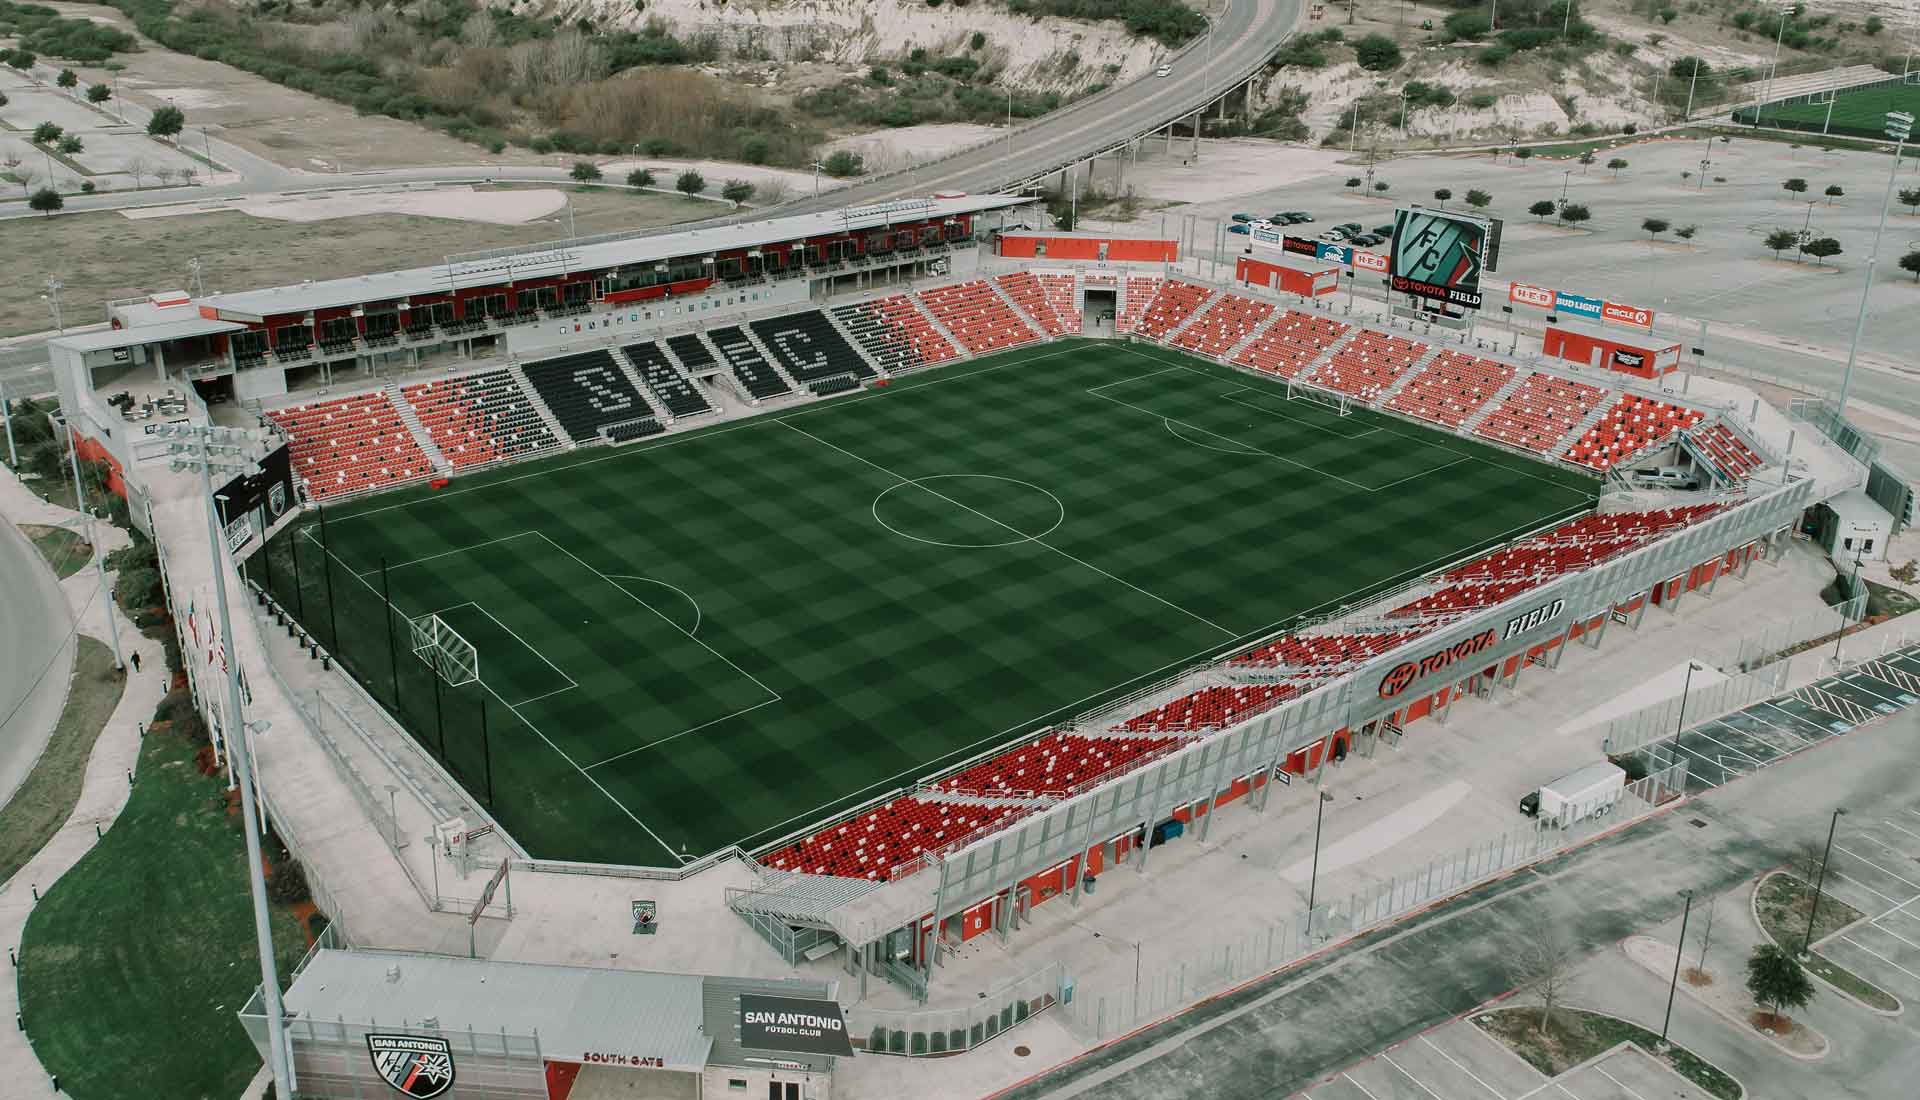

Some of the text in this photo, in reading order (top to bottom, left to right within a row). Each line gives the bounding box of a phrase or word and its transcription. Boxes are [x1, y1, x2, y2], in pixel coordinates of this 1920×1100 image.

[1293, 240, 1315, 252] TOYOTA
[1409, 281, 1481, 305] TOYOTA FIELD
[1556, 297, 1601, 313] BUD LIGHT
[1606, 307, 1646, 323] CIRCLE K
[1420, 597, 1566, 679] TOYOTA FIELD
[745, 1011, 842, 1031] SAN ANTONIO
[799, 1028, 821, 1037] CLUB
[374, 1039, 443, 1051] SAN ANTONIO
[583, 1052, 664, 1068] SOUTH GATE
